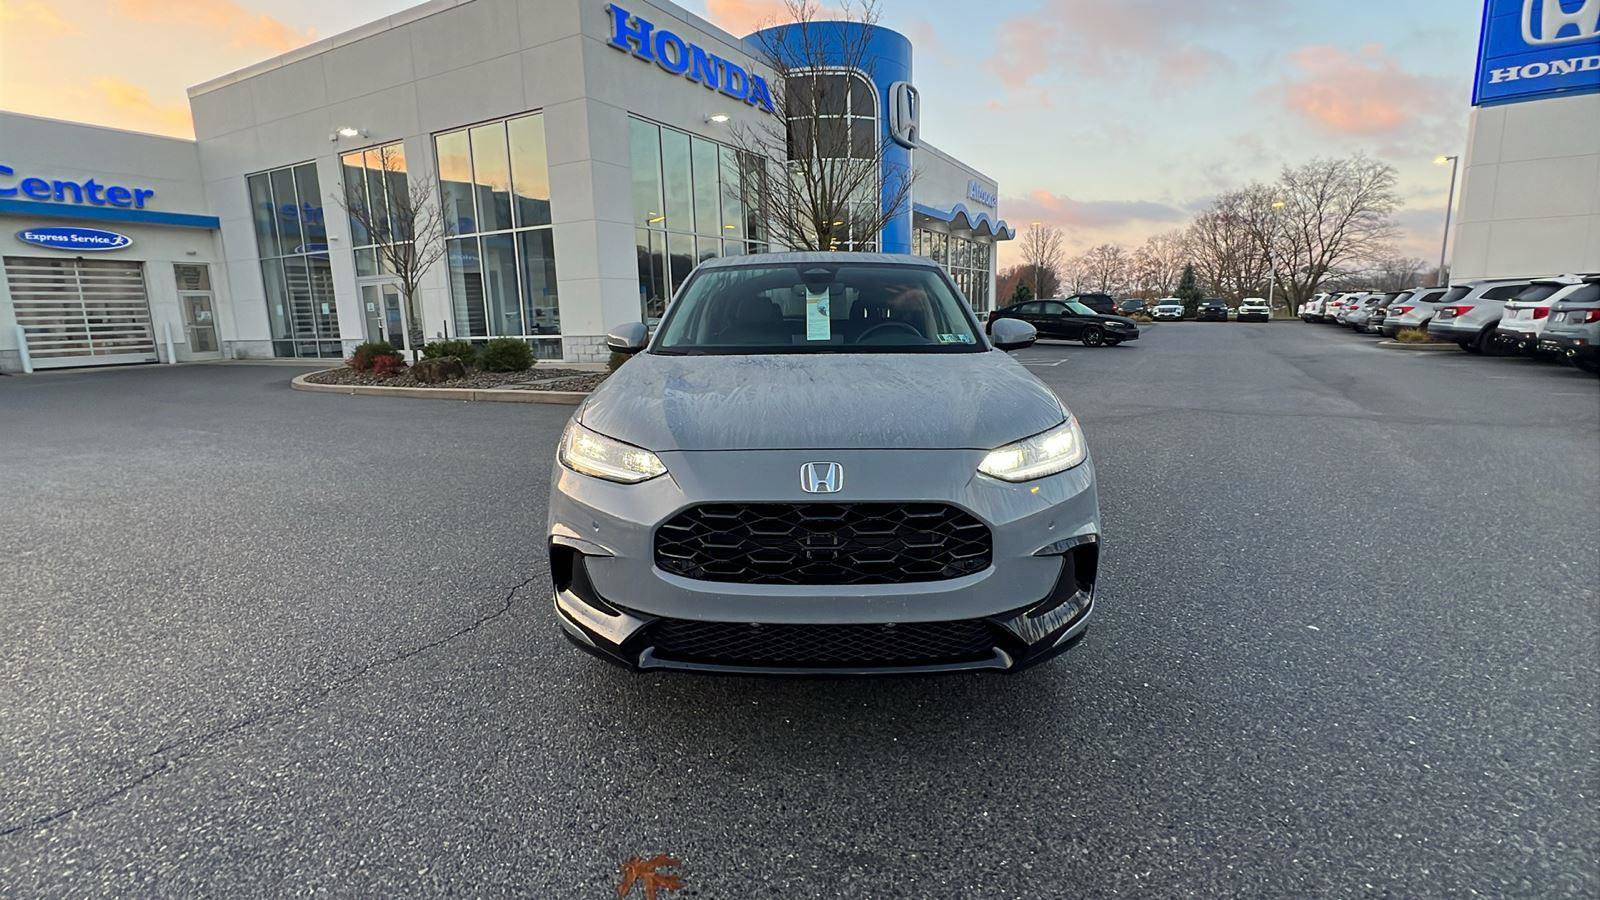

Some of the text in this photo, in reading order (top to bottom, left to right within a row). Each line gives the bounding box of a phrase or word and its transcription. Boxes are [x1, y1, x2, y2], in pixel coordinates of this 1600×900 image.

[607, 3, 775, 113] HONDA
[24, 231, 110, 244] Express Service
